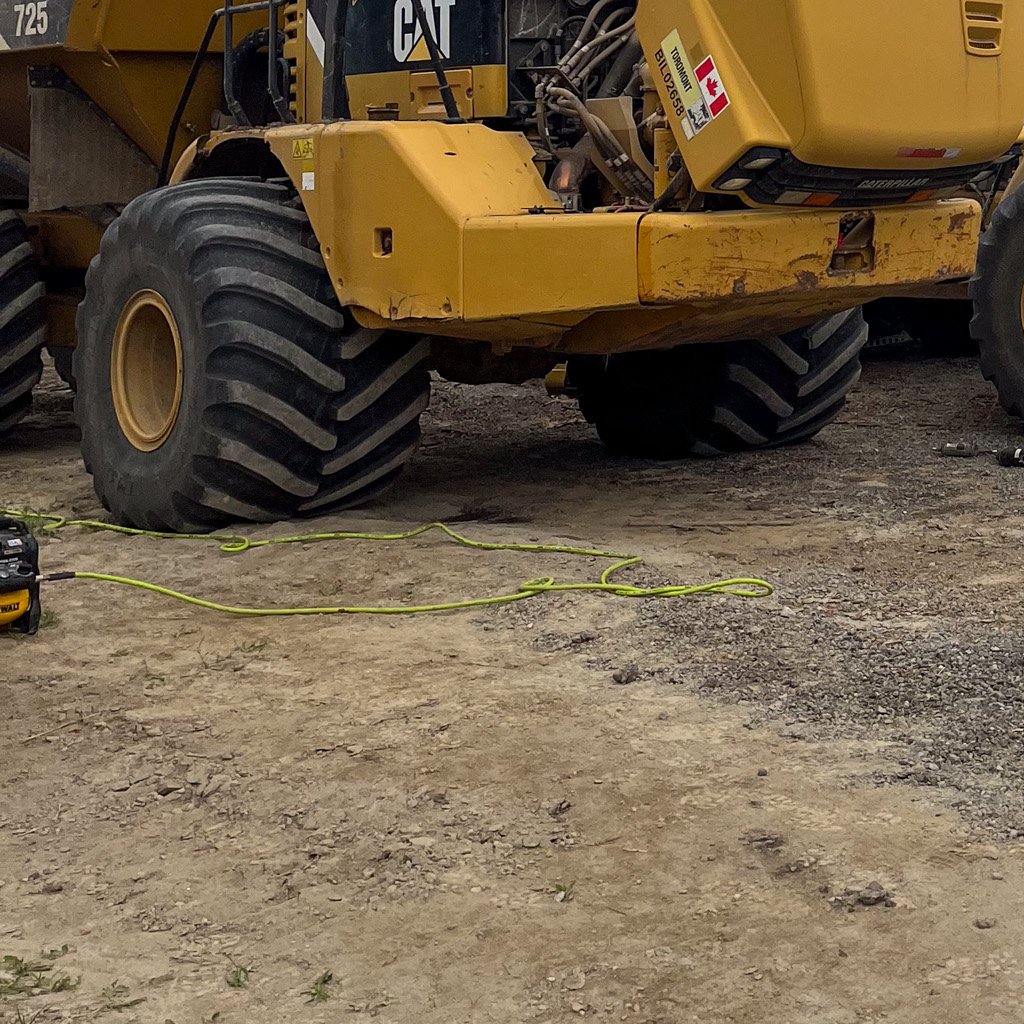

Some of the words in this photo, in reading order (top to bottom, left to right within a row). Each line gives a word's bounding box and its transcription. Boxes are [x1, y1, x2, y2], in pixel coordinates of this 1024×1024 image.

[14, 1, 49, 37] 725
[655, 48, 685, 117] BIL02658
[670, 46, 693, 93] TOROMONT
